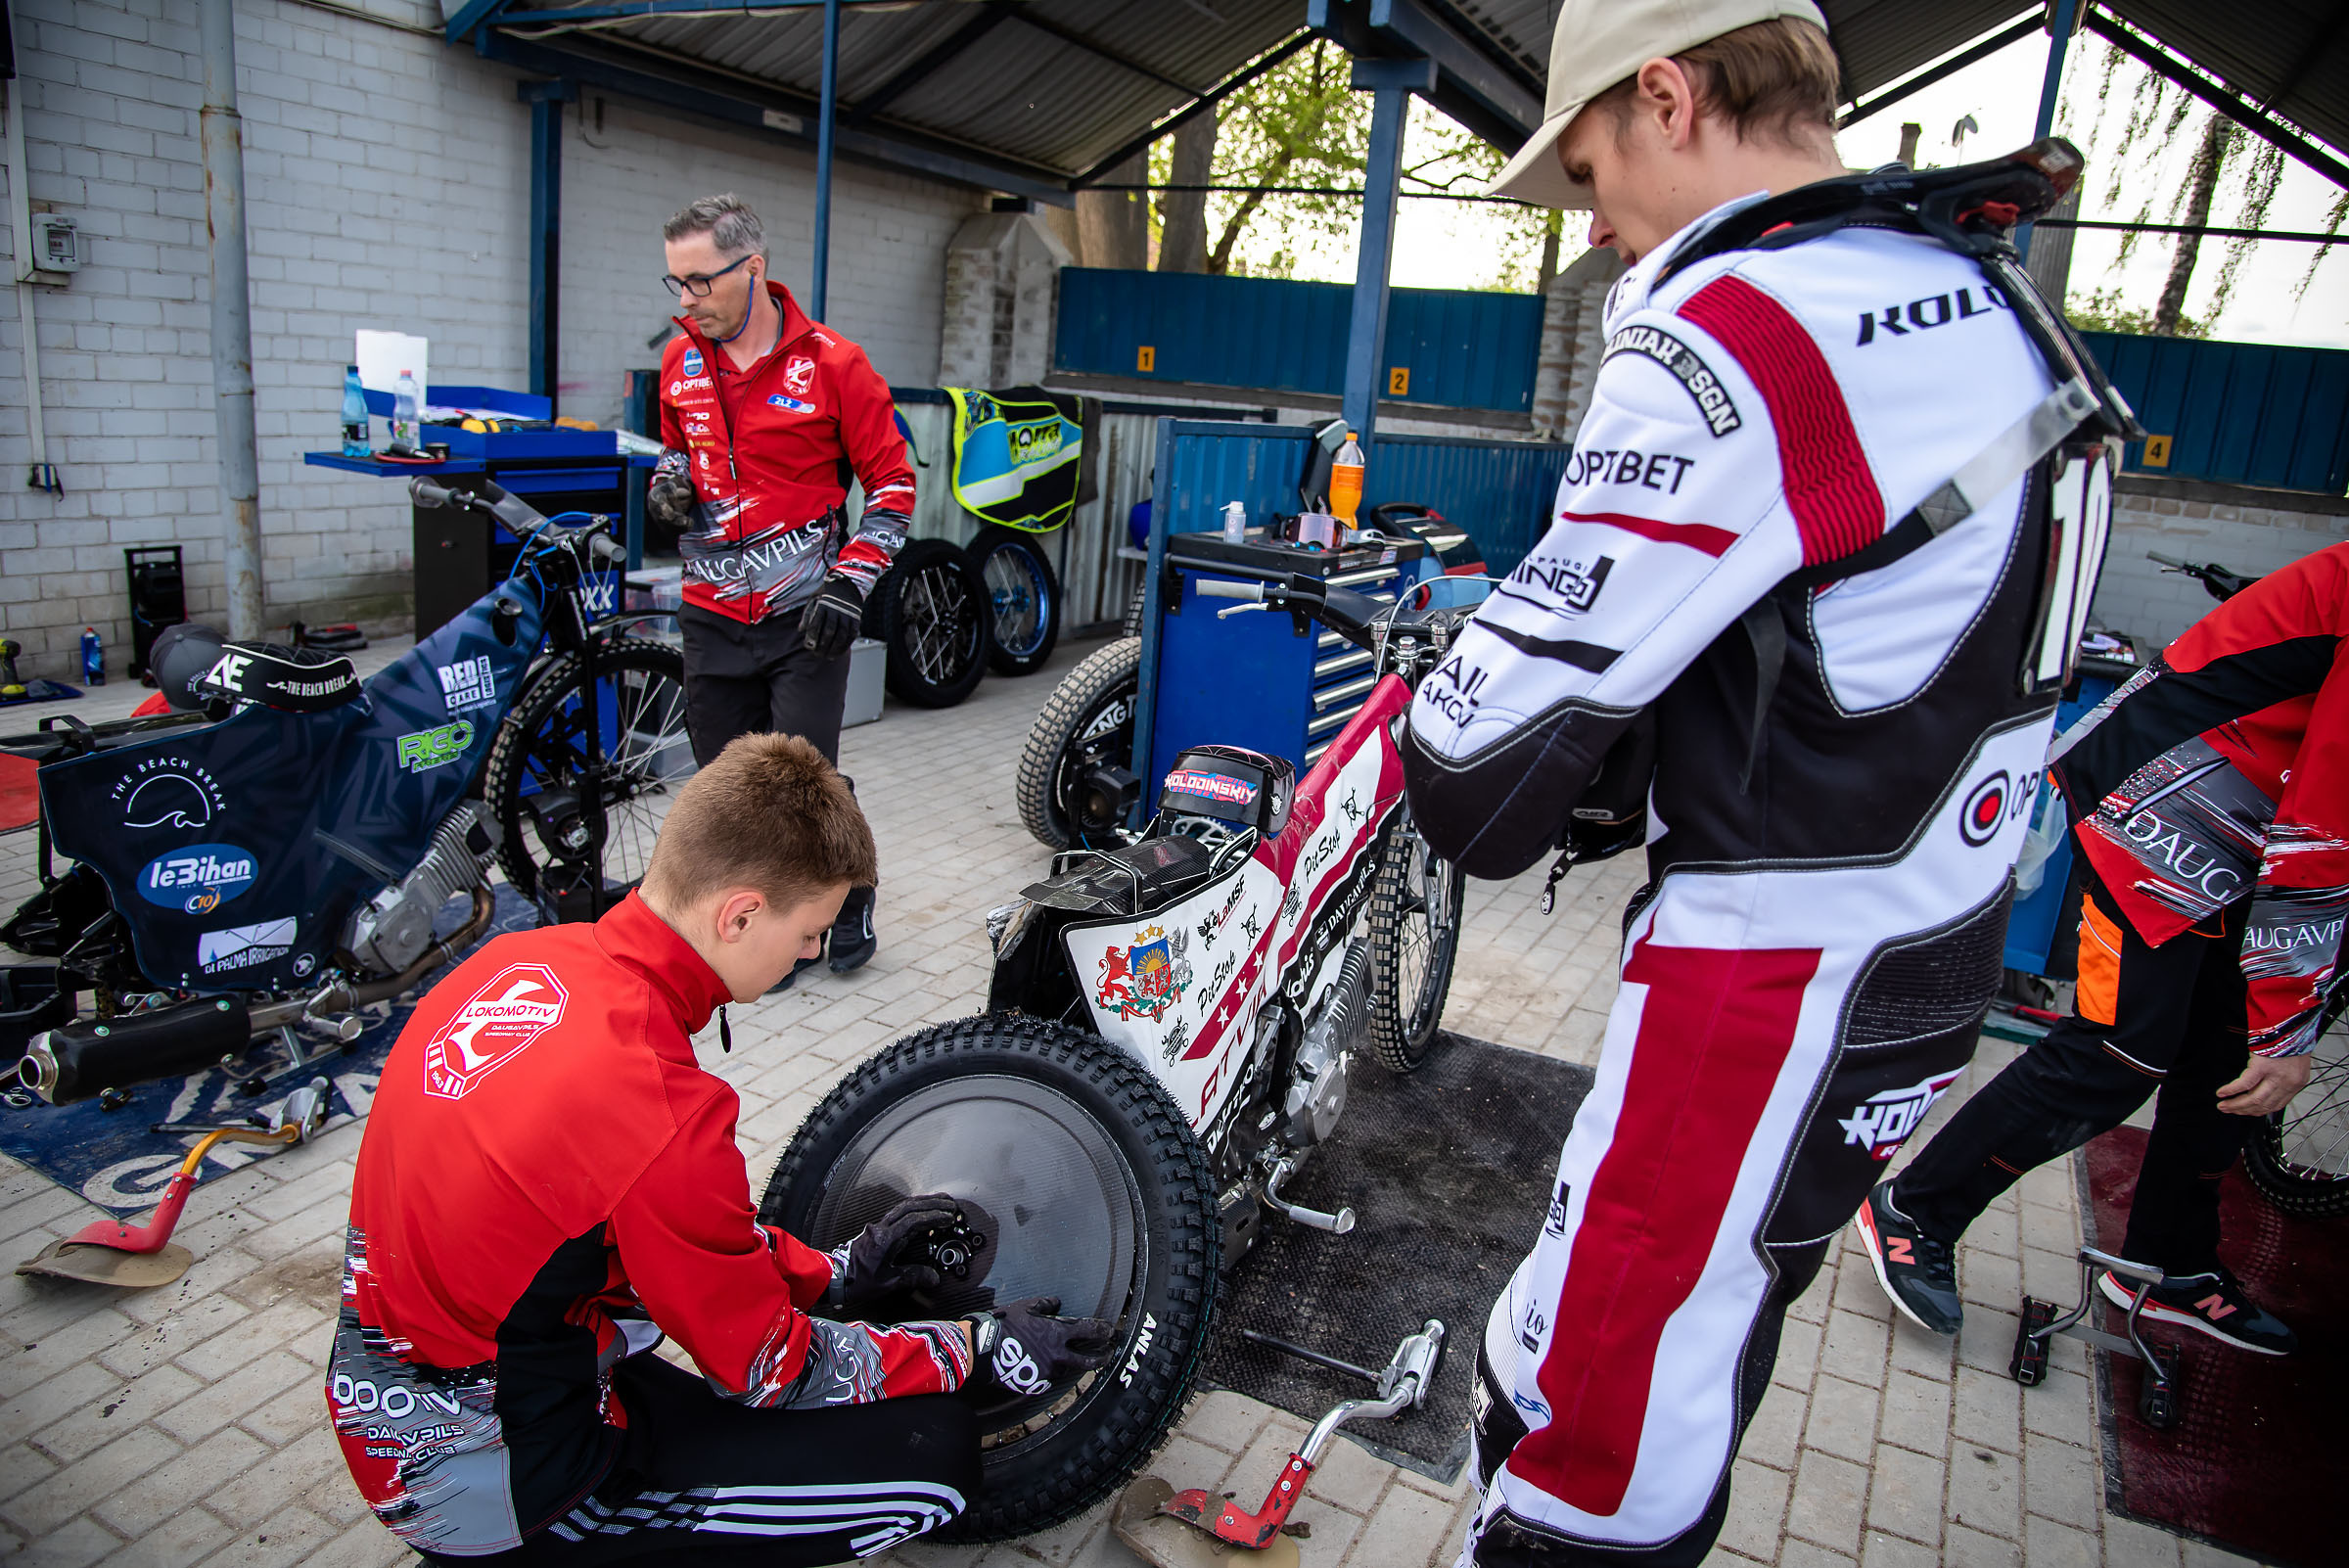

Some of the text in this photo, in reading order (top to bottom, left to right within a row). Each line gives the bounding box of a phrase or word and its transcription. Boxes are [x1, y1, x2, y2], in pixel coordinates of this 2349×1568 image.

[1143, 351, 1149, 368] 1
[682, 376, 714, 391] OPTIBE
[1394, 372, 1405, 391] 2
[2150, 443, 2162, 459] 4
[438, 660, 480, 694] RED
[396, 719, 475, 769] RIGO
[111, 757, 227, 811] THE BEACH BREAK
[2123, 810, 2241, 902] DAUG
[205, 961, 216, 975] DI
[216, 947, 249, 972] PALMA
[466, 1004, 556, 1018] LOKOMOTIV
[1190, 979, 1267, 1129] ATVIA
[431, 1070, 445, 1090] 1963
[1886, 1236, 1916, 1266] N
[2193, 1293, 2237, 1320] N
[1119, 1312, 1158, 1390] ANLAS
